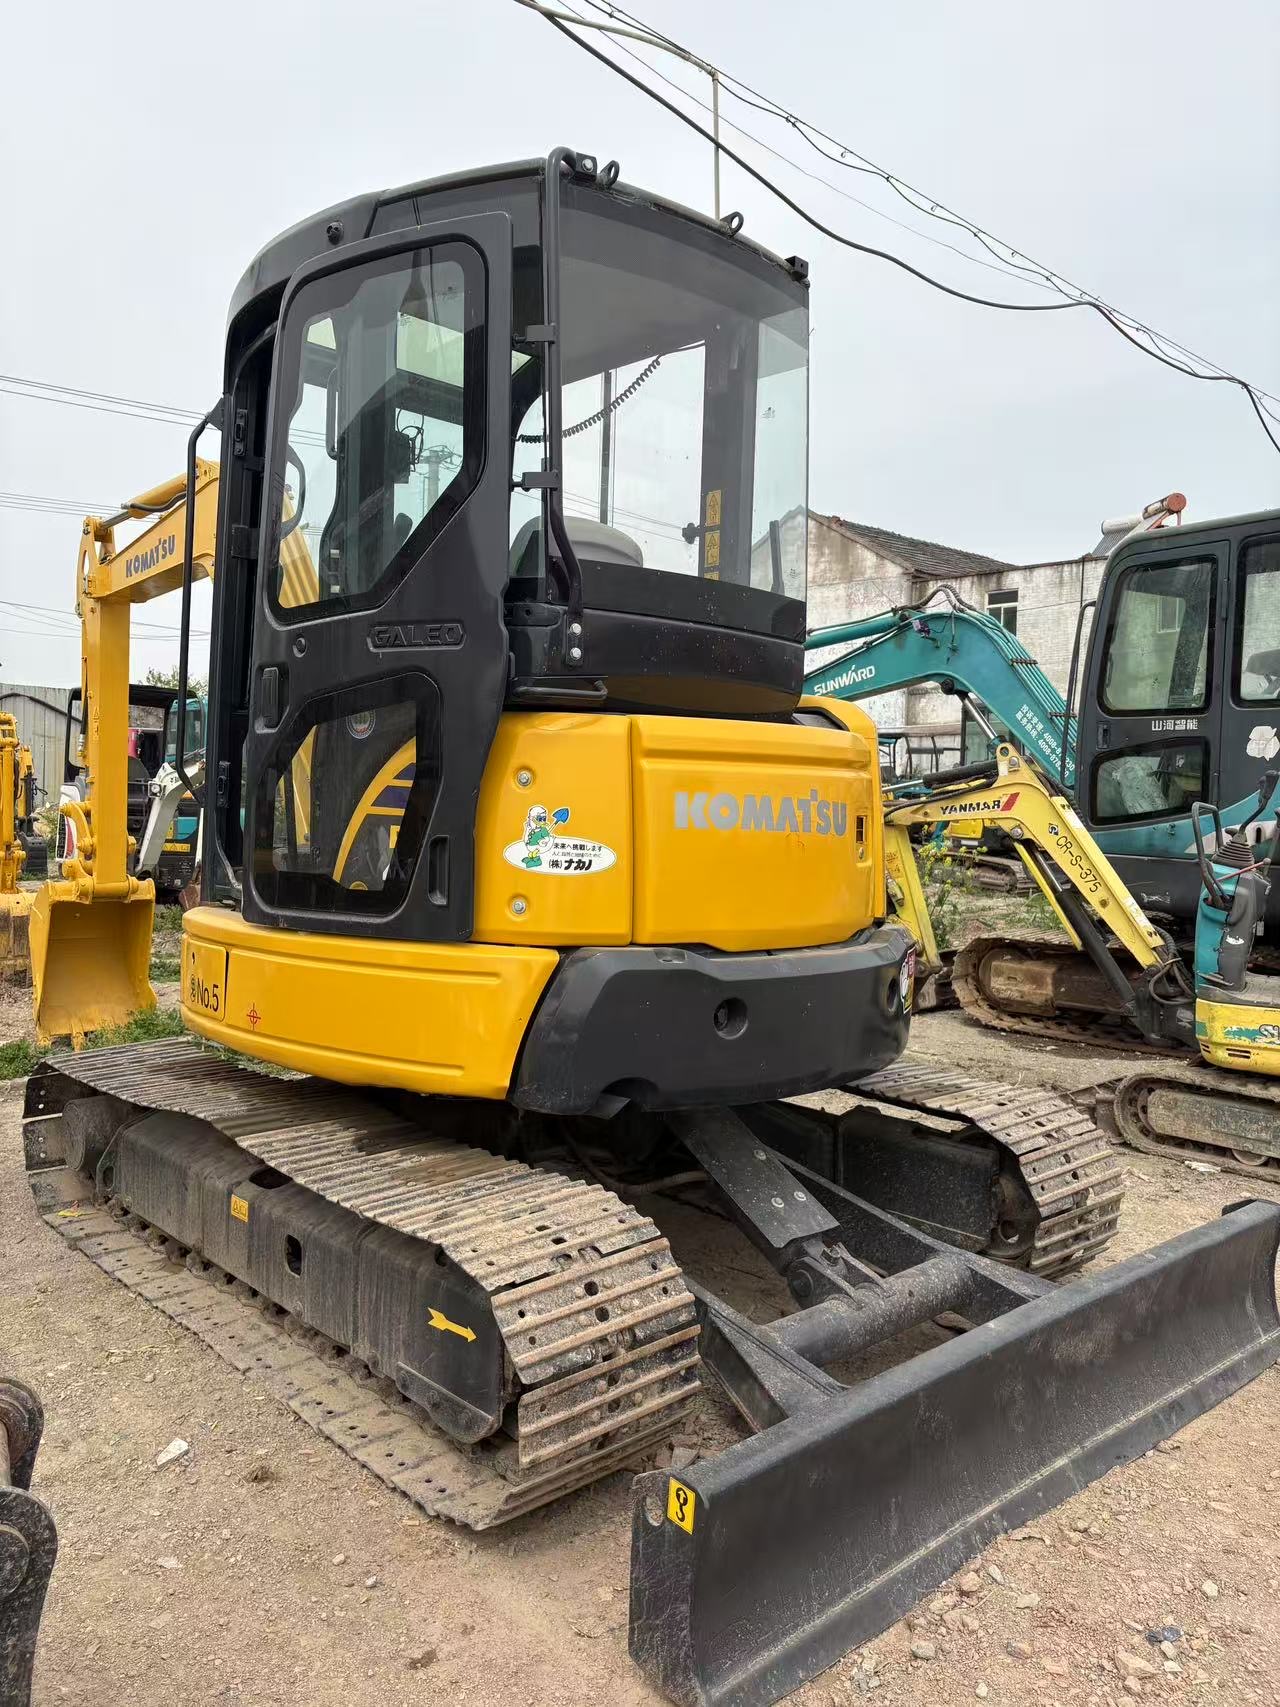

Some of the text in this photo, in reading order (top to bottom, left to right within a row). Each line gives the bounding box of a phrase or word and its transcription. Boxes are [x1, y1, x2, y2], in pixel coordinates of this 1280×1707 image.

[125, 534, 175, 578] KOMATSU
[372, 623, 463, 647] GALEO
[813, 664, 876, 696] SUNWARD
[1151, 718, 1199, 731] 山河智能
[674, 788, 848, 837] KOMATSU
[939, 799, 1001, 815] YANMAR
[1056, 835, 1102, 893] CR-S-375
[197, 977, 219, 1012] No.5
